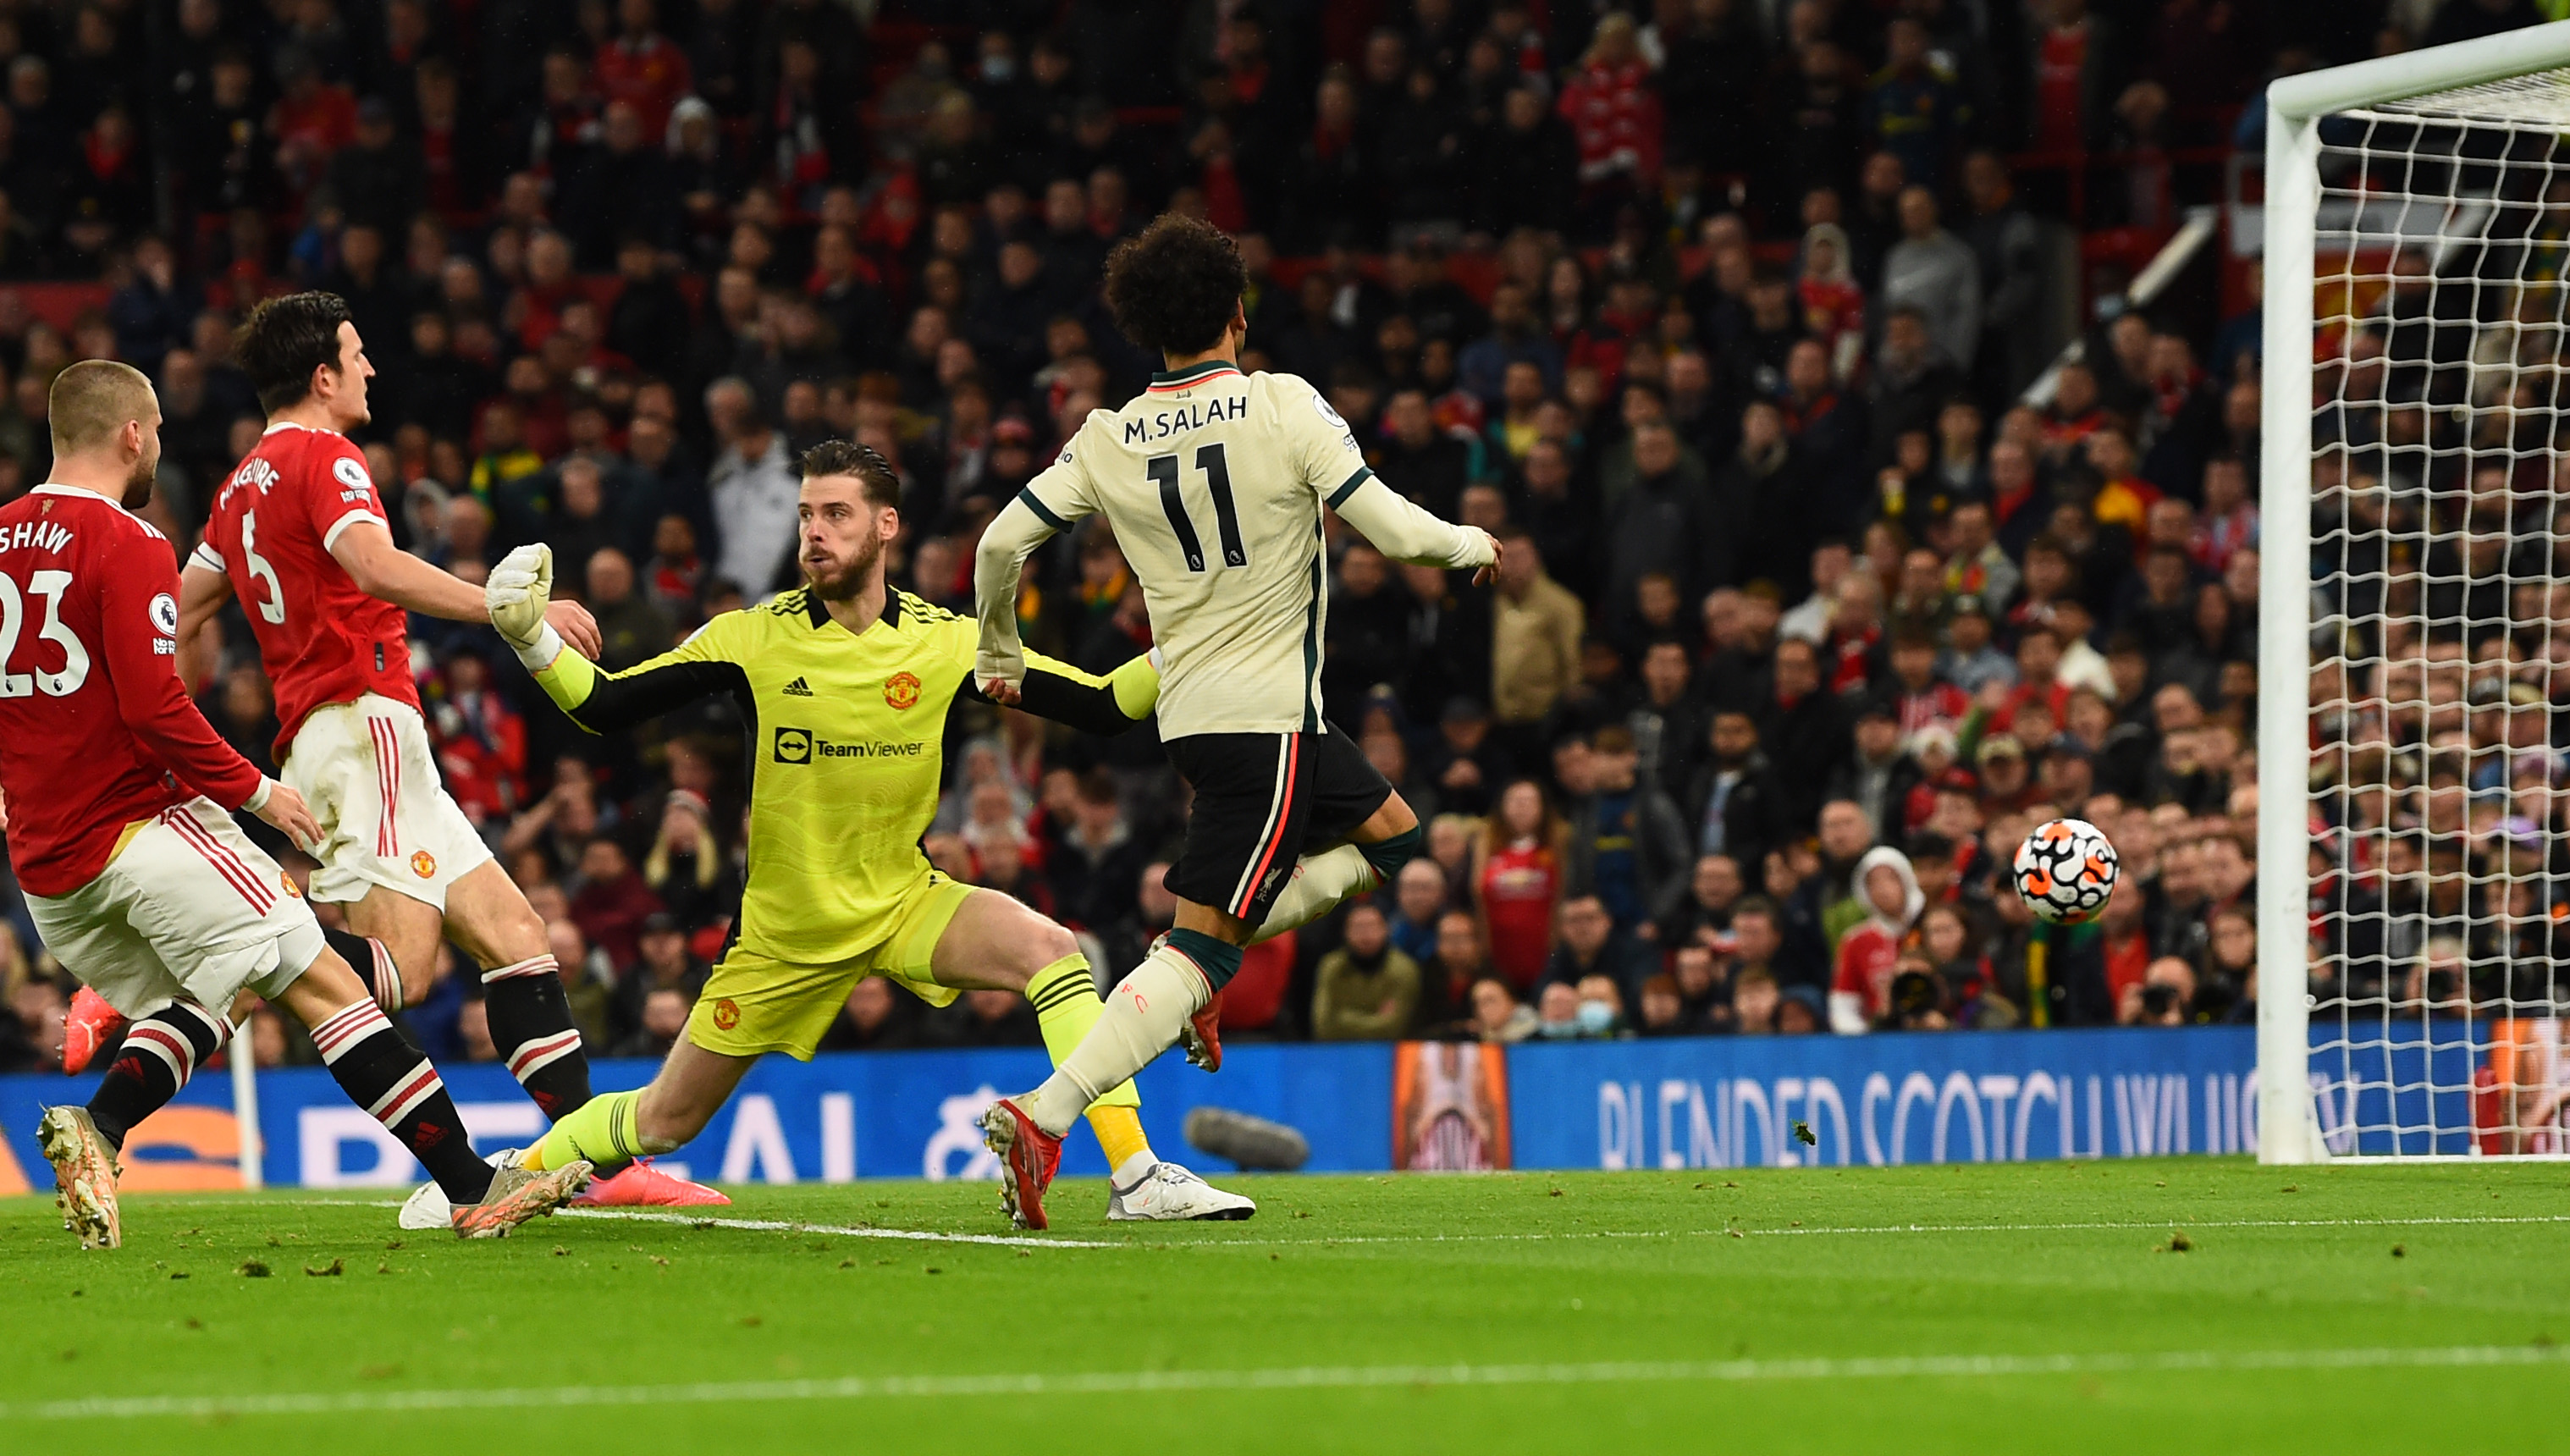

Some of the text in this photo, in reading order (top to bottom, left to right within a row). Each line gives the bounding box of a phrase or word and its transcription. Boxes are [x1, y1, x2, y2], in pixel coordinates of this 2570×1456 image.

[1124, 396, 1247, 444] M.SALAH
[0, 521, 74, 554] SHAW
[1146, 443, 1248, 573] 11
[242, 507, 285, 625] 5
[0, 570, 91, 698] 23
[815, 740, 925, 758] TeamViewer
